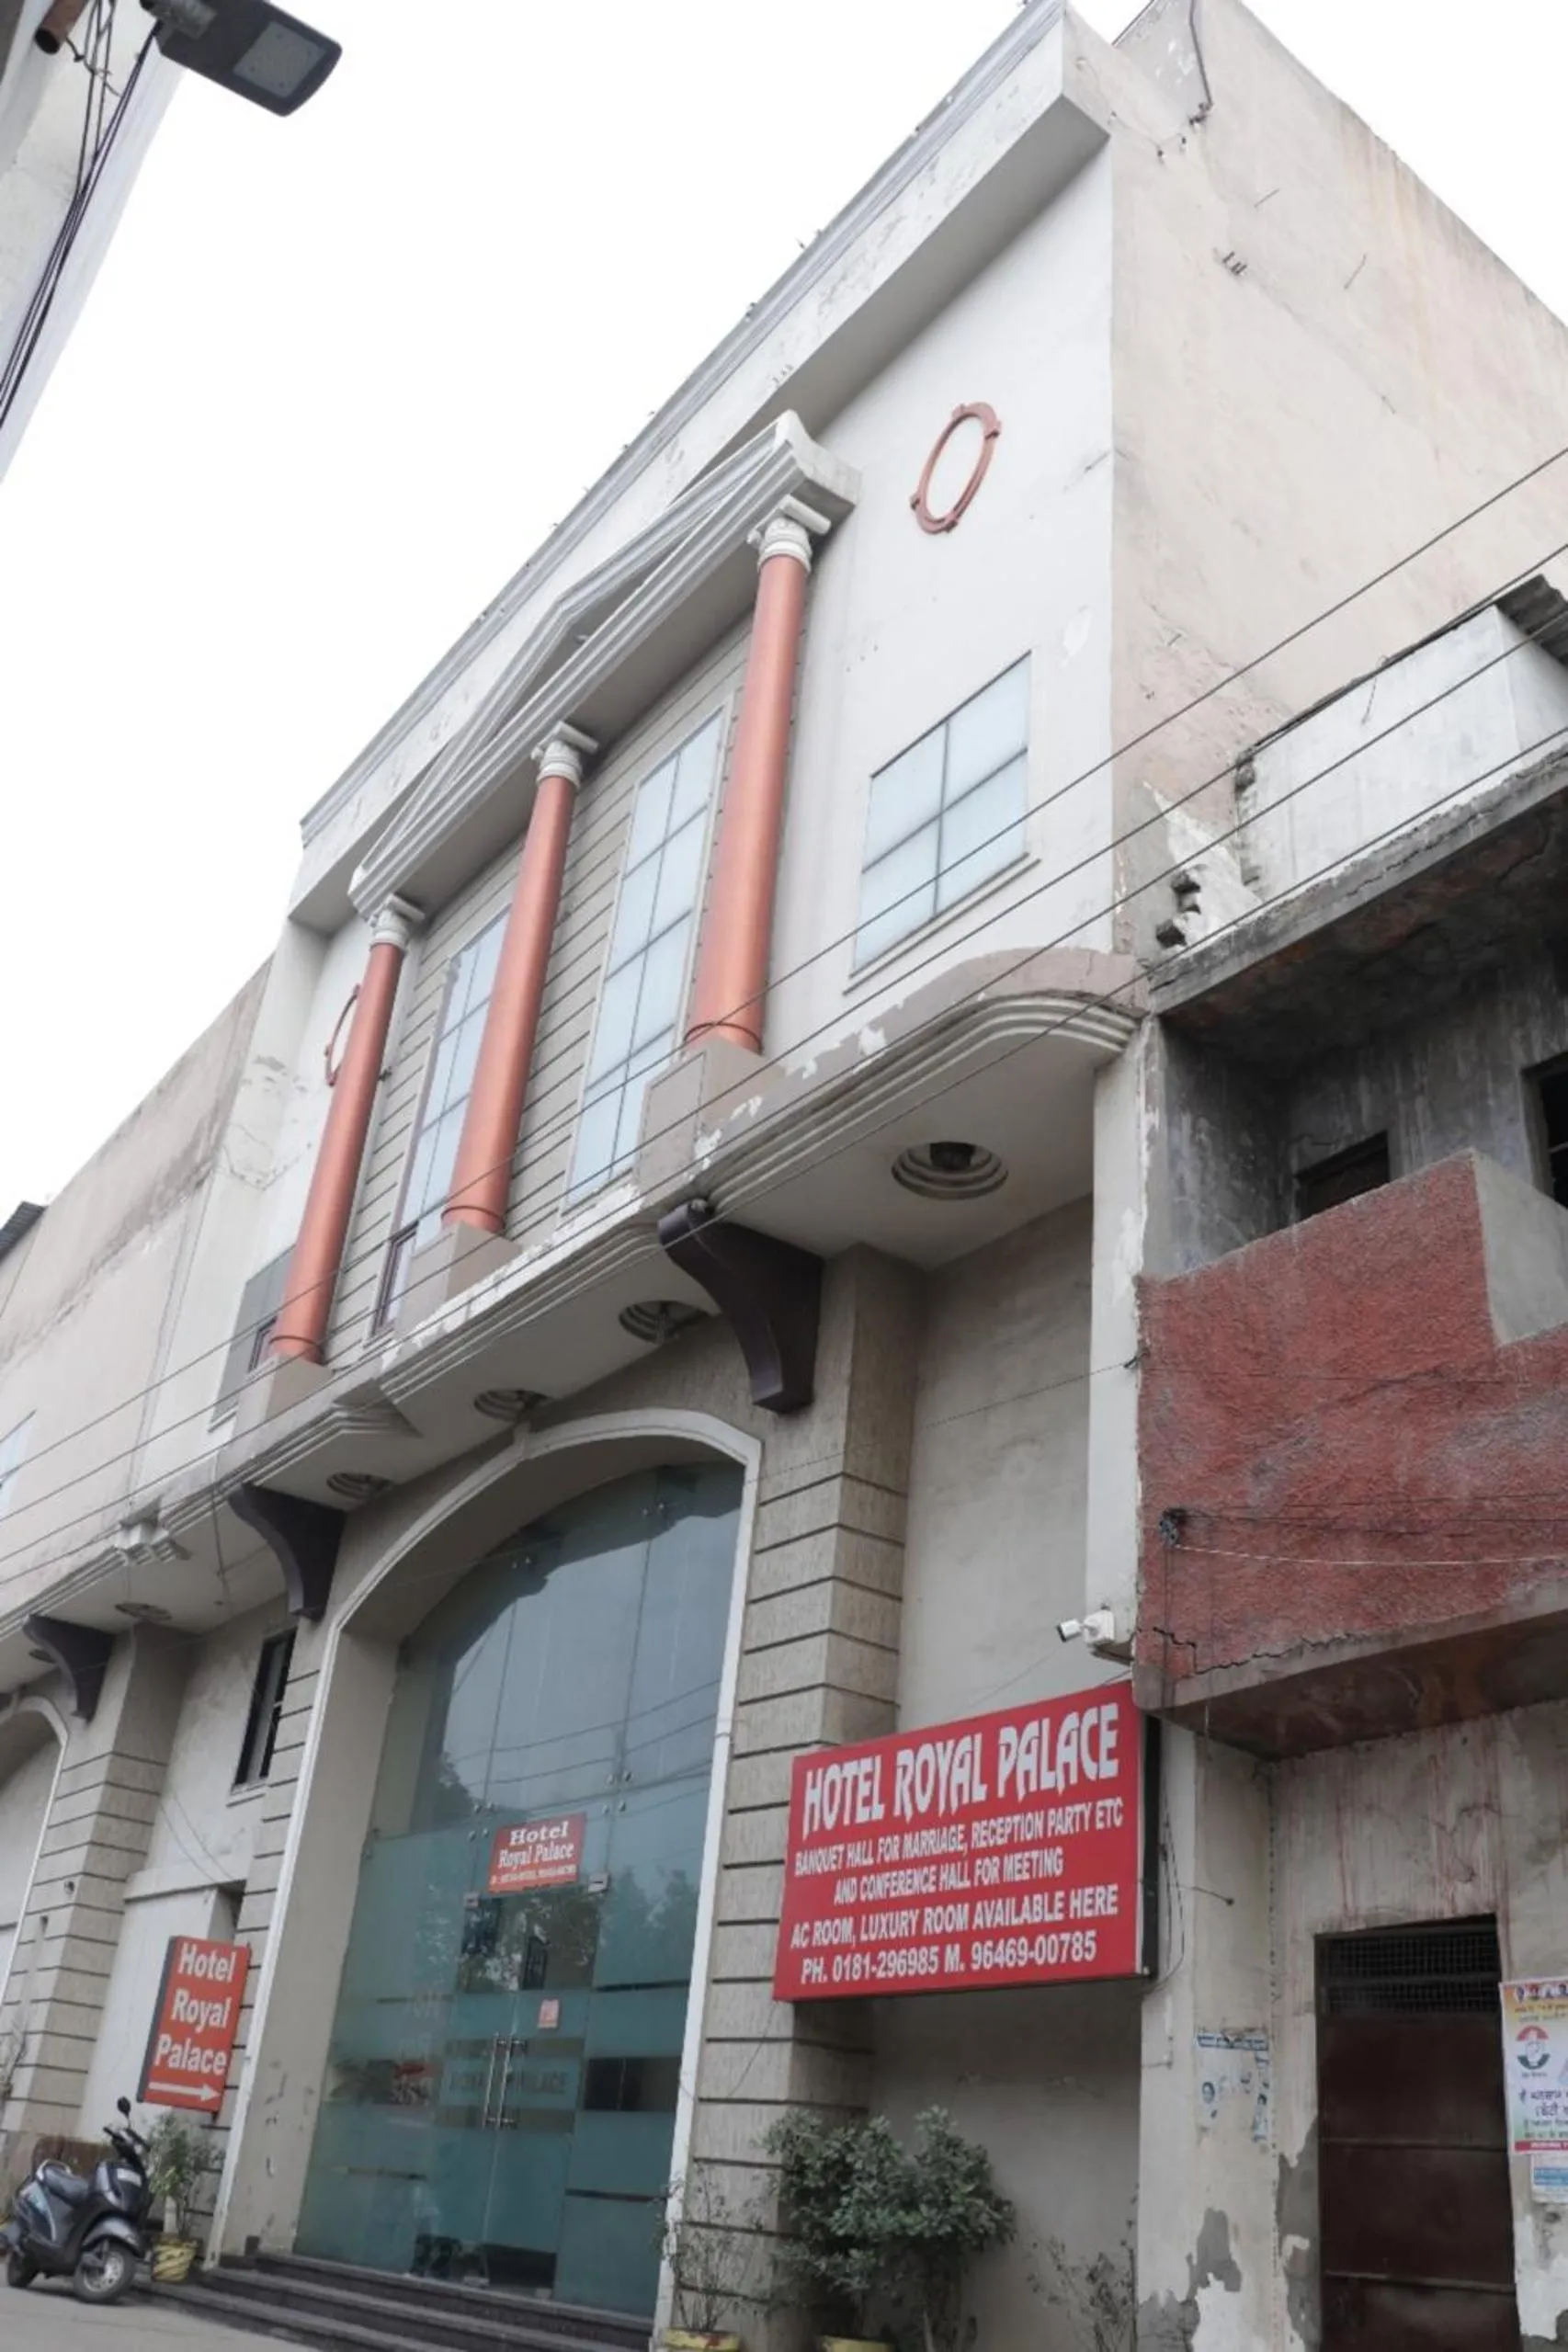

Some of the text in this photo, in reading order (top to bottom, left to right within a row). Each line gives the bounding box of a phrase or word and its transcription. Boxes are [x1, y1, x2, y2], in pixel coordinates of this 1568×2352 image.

[802, 1702, 1119, 1841] HOTEL ROYAL PALACE
[509, 1820, 569, 1846] Hotel
[794, 1796, 1124, 1877] BANQUET HALL FOR MARRIAGE, RECEPTION PARTY ETC
[834, 1846, 1063, 1905] AND CONFERENCE HALL FOR MEETING
[790, 1883, 1119, 1949] AC ROOM, LUXURY ROOM AVAILABLE HERE
[177, 1942, 237, 1983] Hotel
[801, 1956, 828, 1984] PH.
[944, 1943, 965, 1973] M.
[971, 1929, 1097, 1971] 96469-00785
[170, 1987, 233, 2033] Royal
[153, 2033, 228, 2076] Palace
